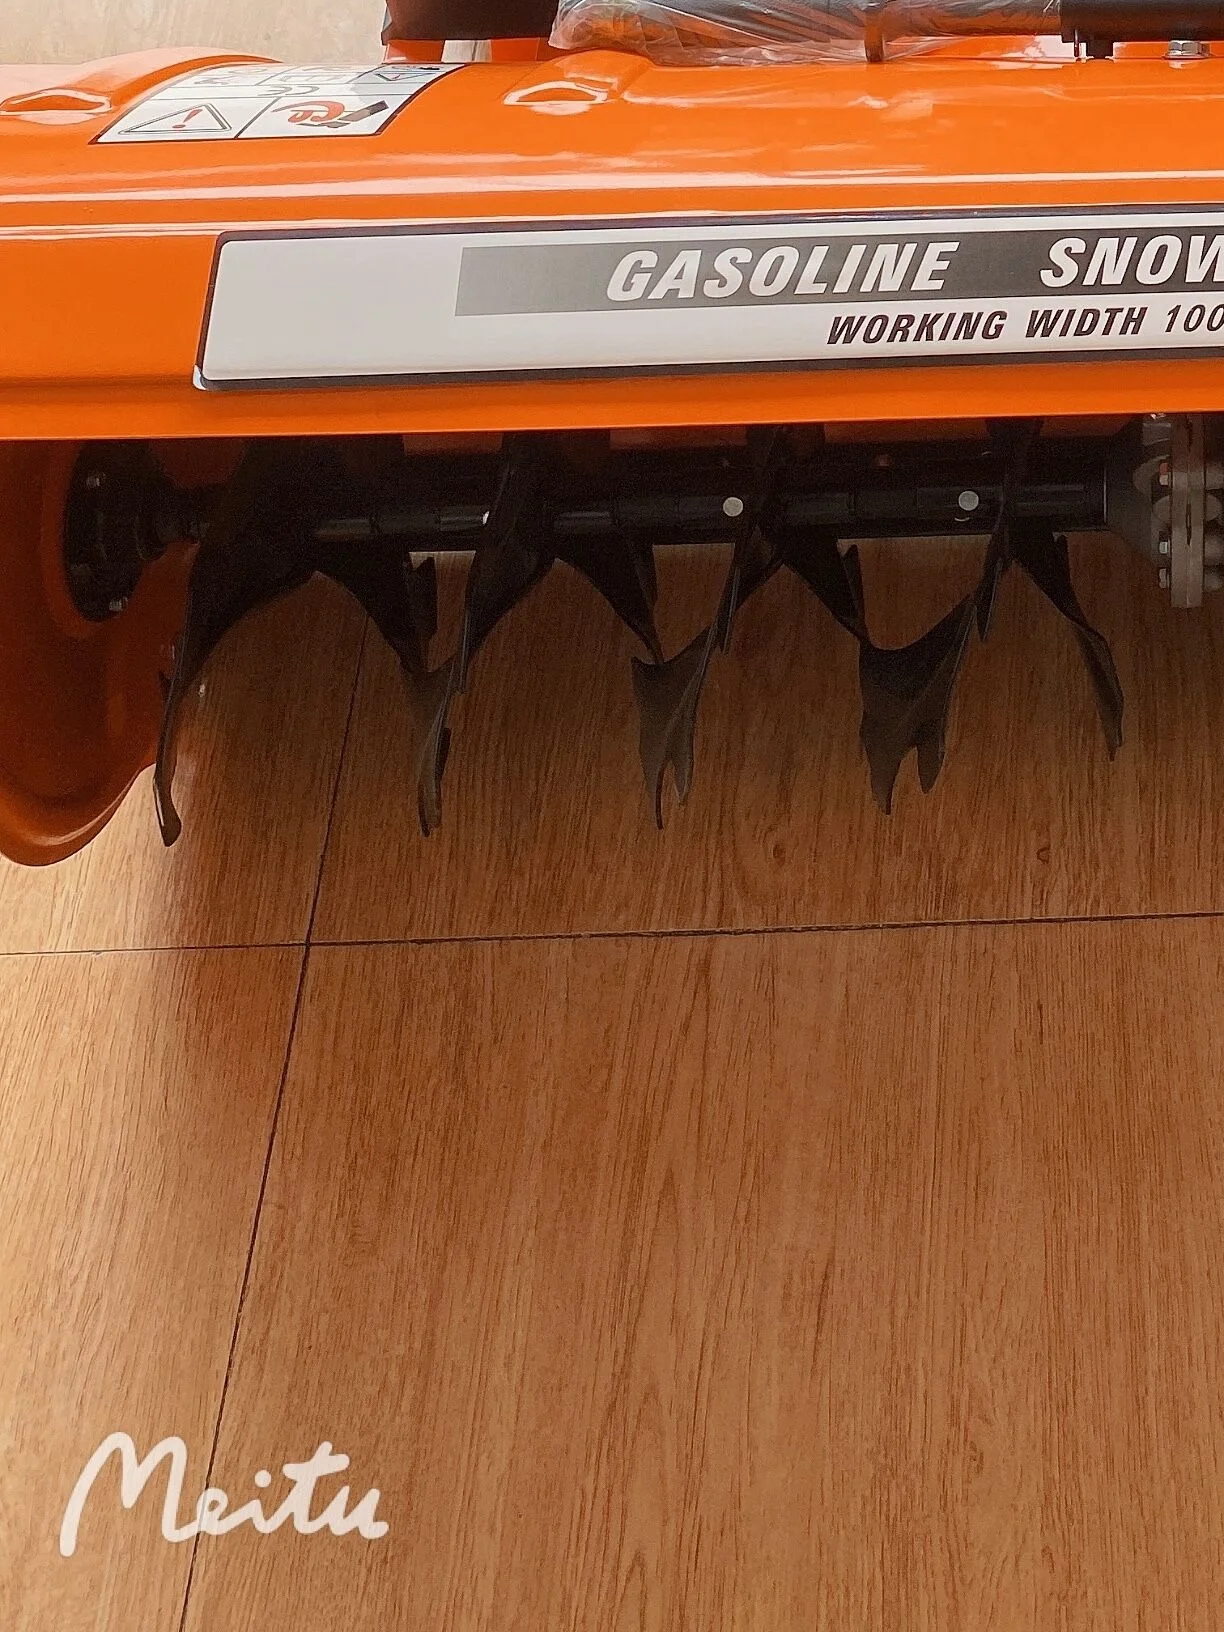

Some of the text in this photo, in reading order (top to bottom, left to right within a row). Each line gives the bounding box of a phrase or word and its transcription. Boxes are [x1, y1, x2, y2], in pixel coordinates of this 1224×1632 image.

[606, 241, 960, 301] GASOLINE
[826, 310, 1008, 345] WORKING
[1024, 306, 1148, 339] WIDTH
